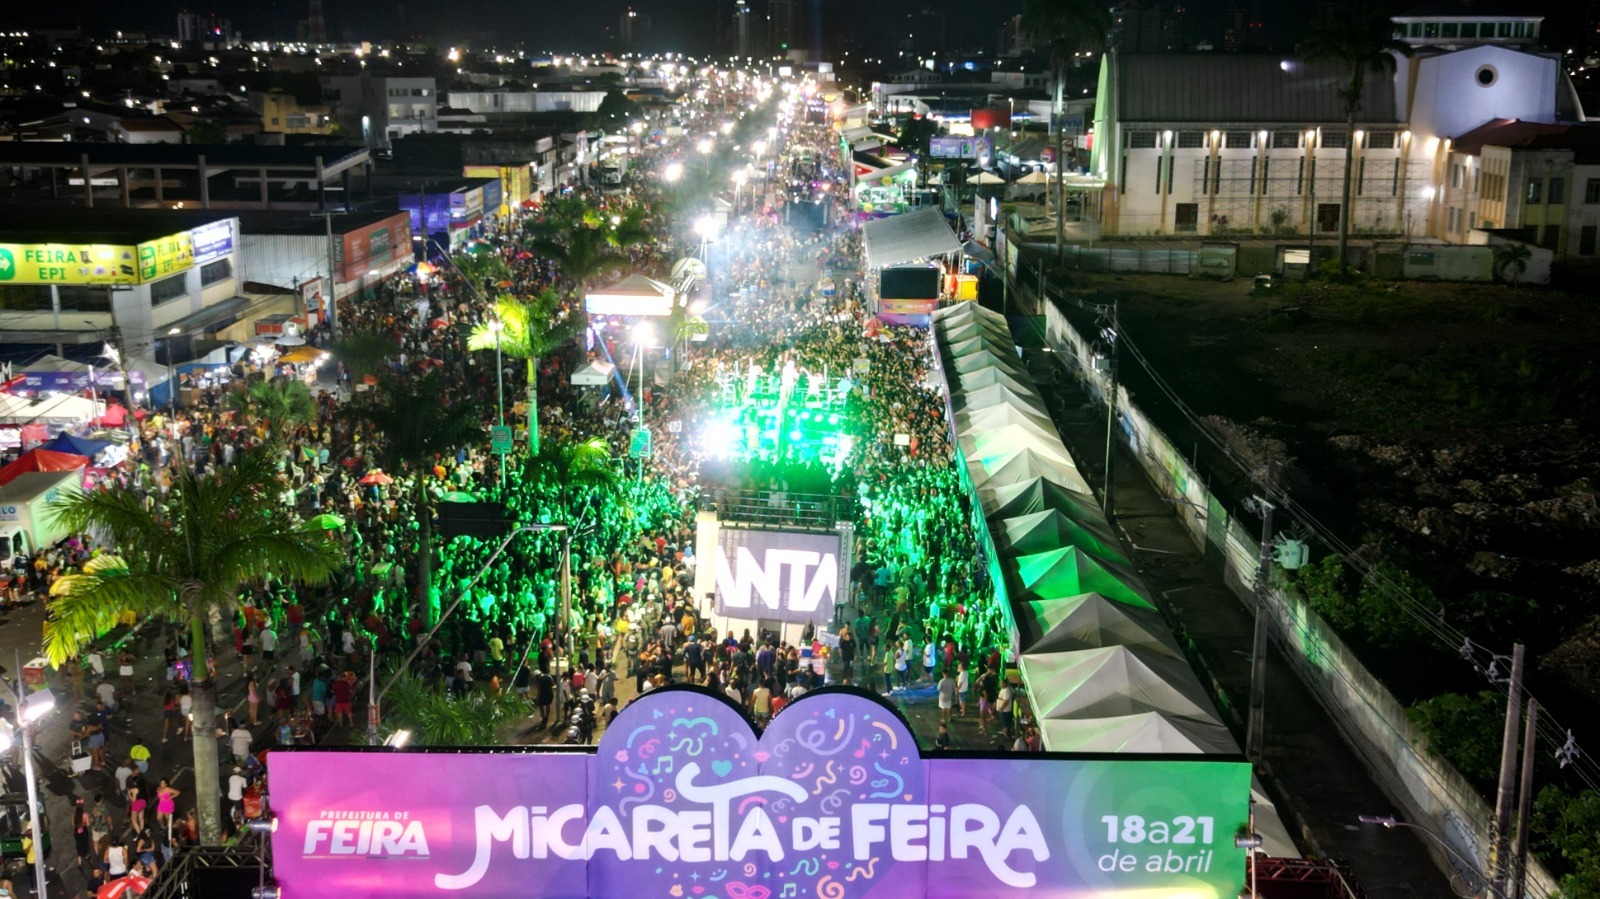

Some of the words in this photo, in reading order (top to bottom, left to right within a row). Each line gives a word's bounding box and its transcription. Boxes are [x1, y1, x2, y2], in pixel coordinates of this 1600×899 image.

[25, 250, 76, 264] FEIRA
[39, 267, 66, 279] EPI
[320, 811, 390, 820] PREFEITURA
[394, 811, 409, 820] DE
[303, 820, 430, 855] FEIRA
[791, 817, 839, 850] DE
[1098, 850, 1135, 874] de
[1145, 849, 1213, 874] abril
